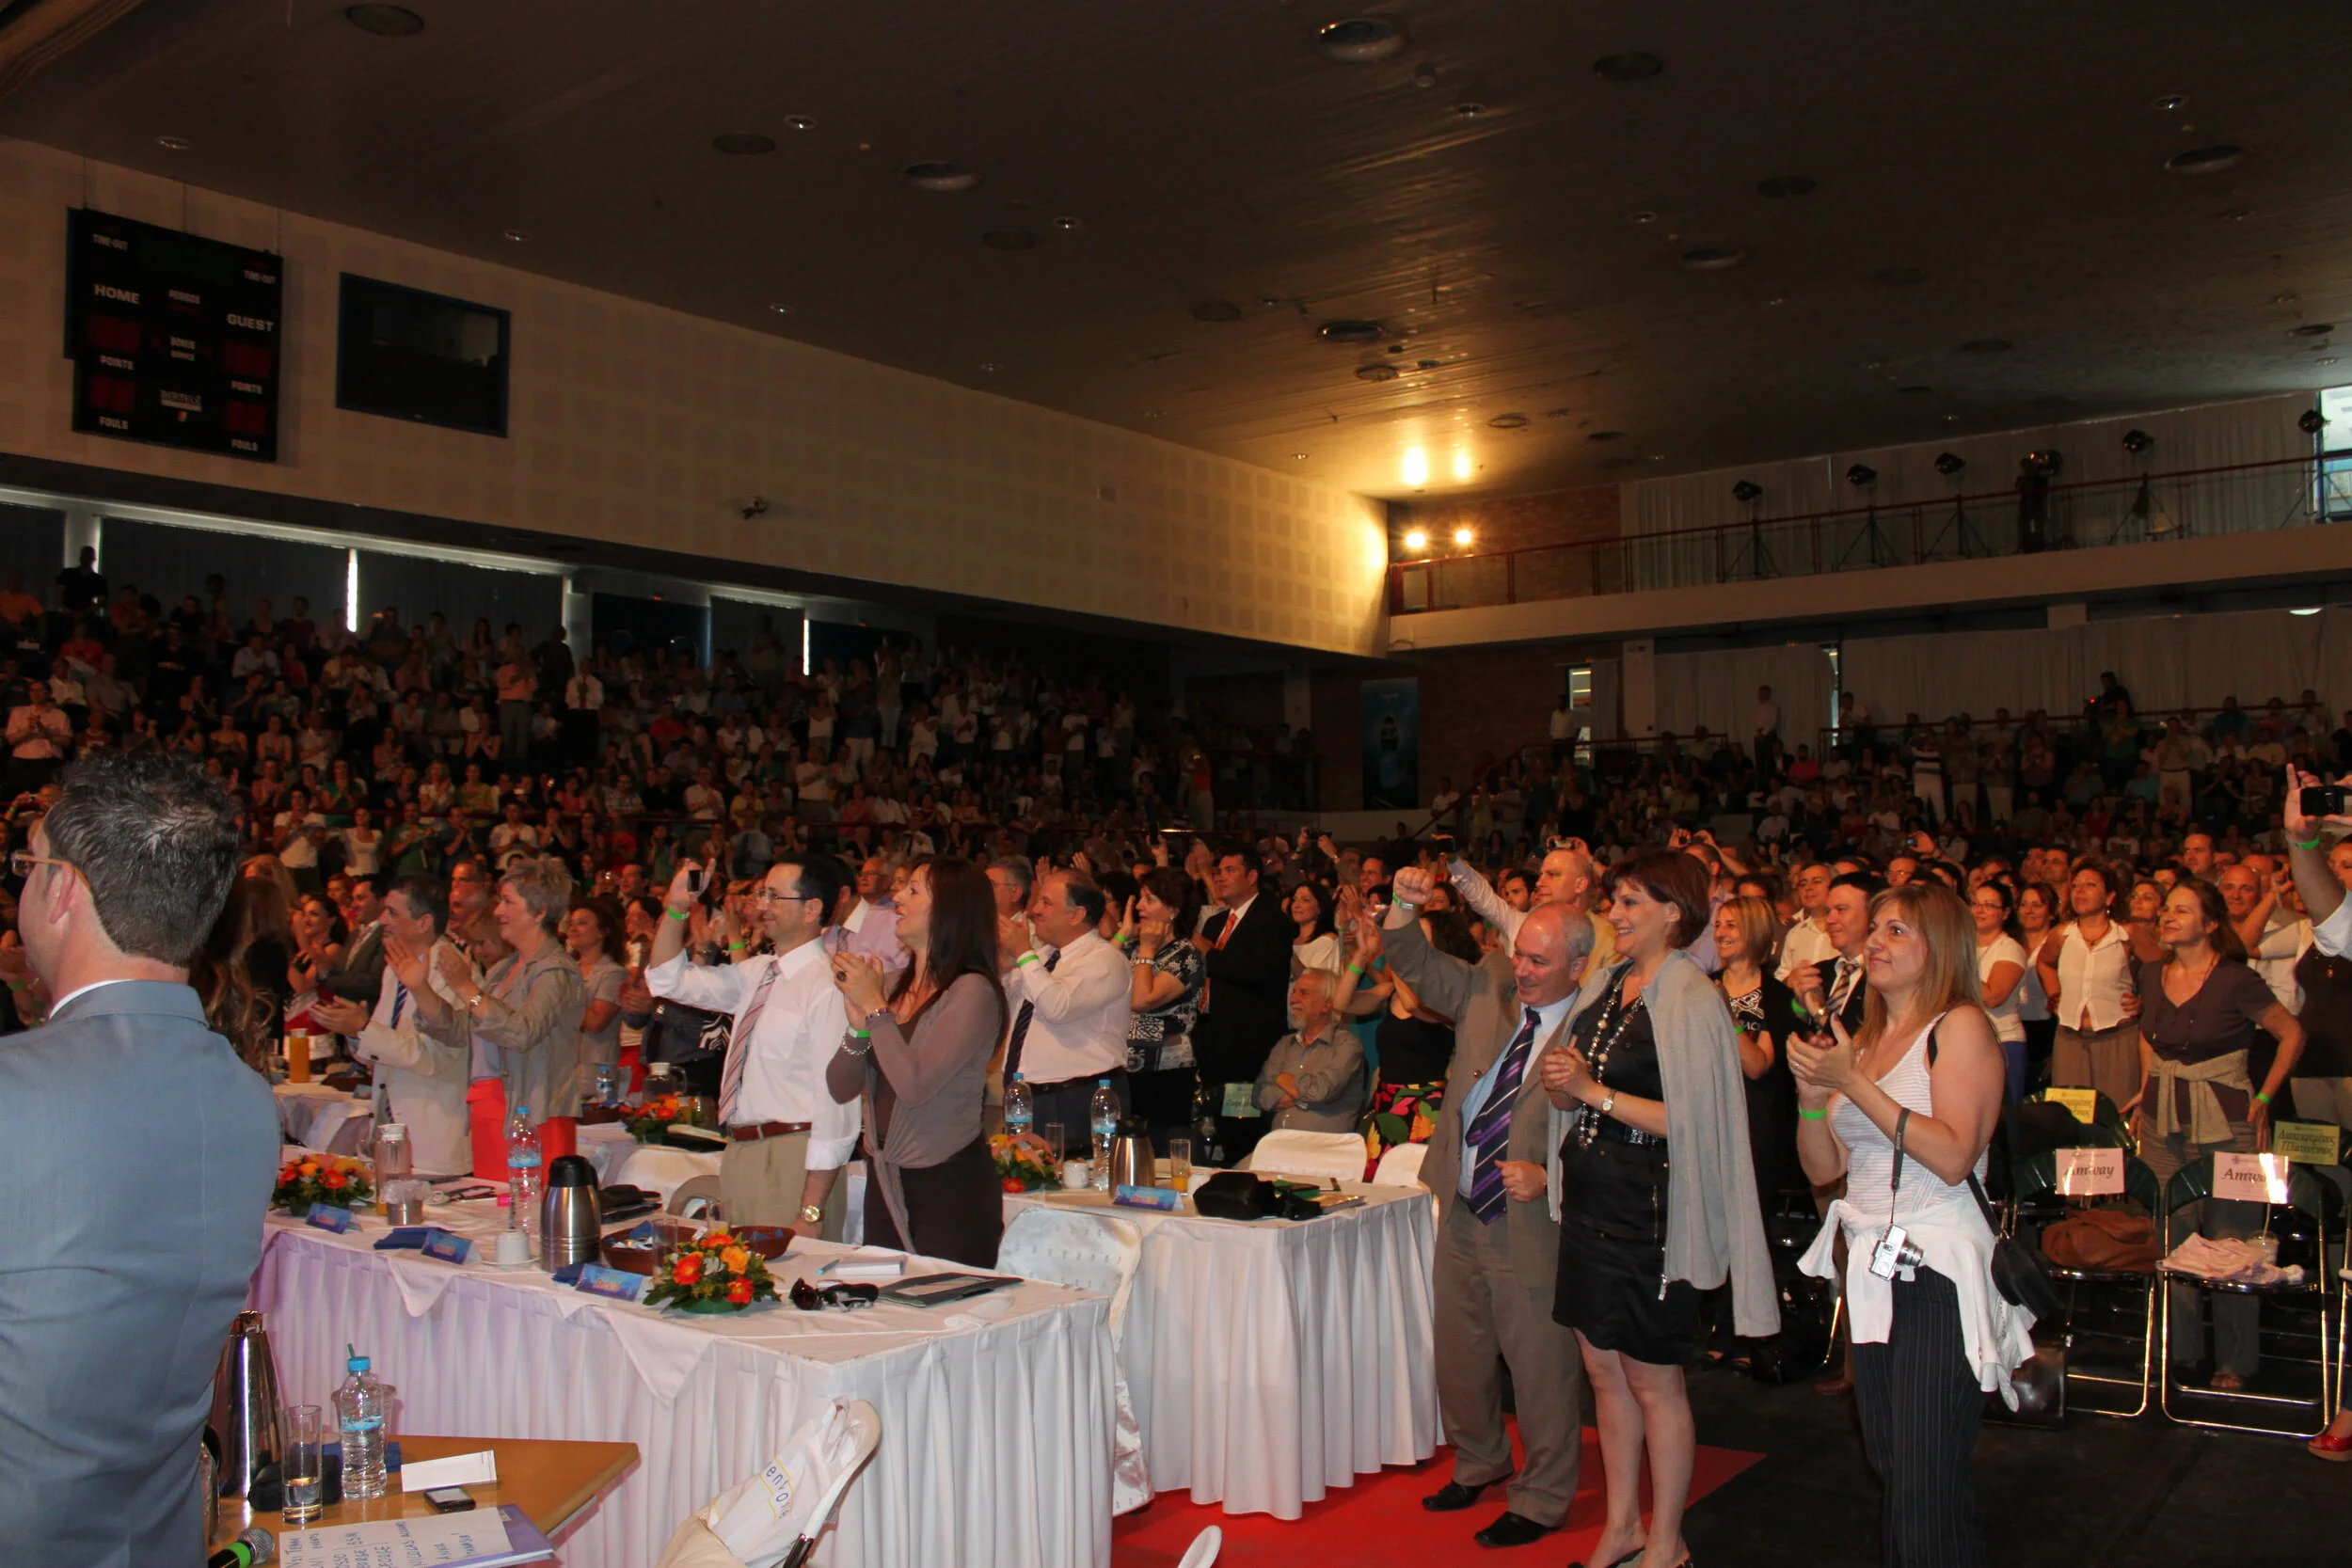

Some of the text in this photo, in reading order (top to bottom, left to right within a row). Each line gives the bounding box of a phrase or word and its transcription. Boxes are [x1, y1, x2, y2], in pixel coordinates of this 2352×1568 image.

[94, 283, 140, 305] HOME
[226, 312, 275, 332] GUEST
[100, 354, 135, 372] POINTS
[231, 379, 263, 395] POINTS
[100, 415, 130, 430] FOULS
[231, 438, 259, 452] FOULS
